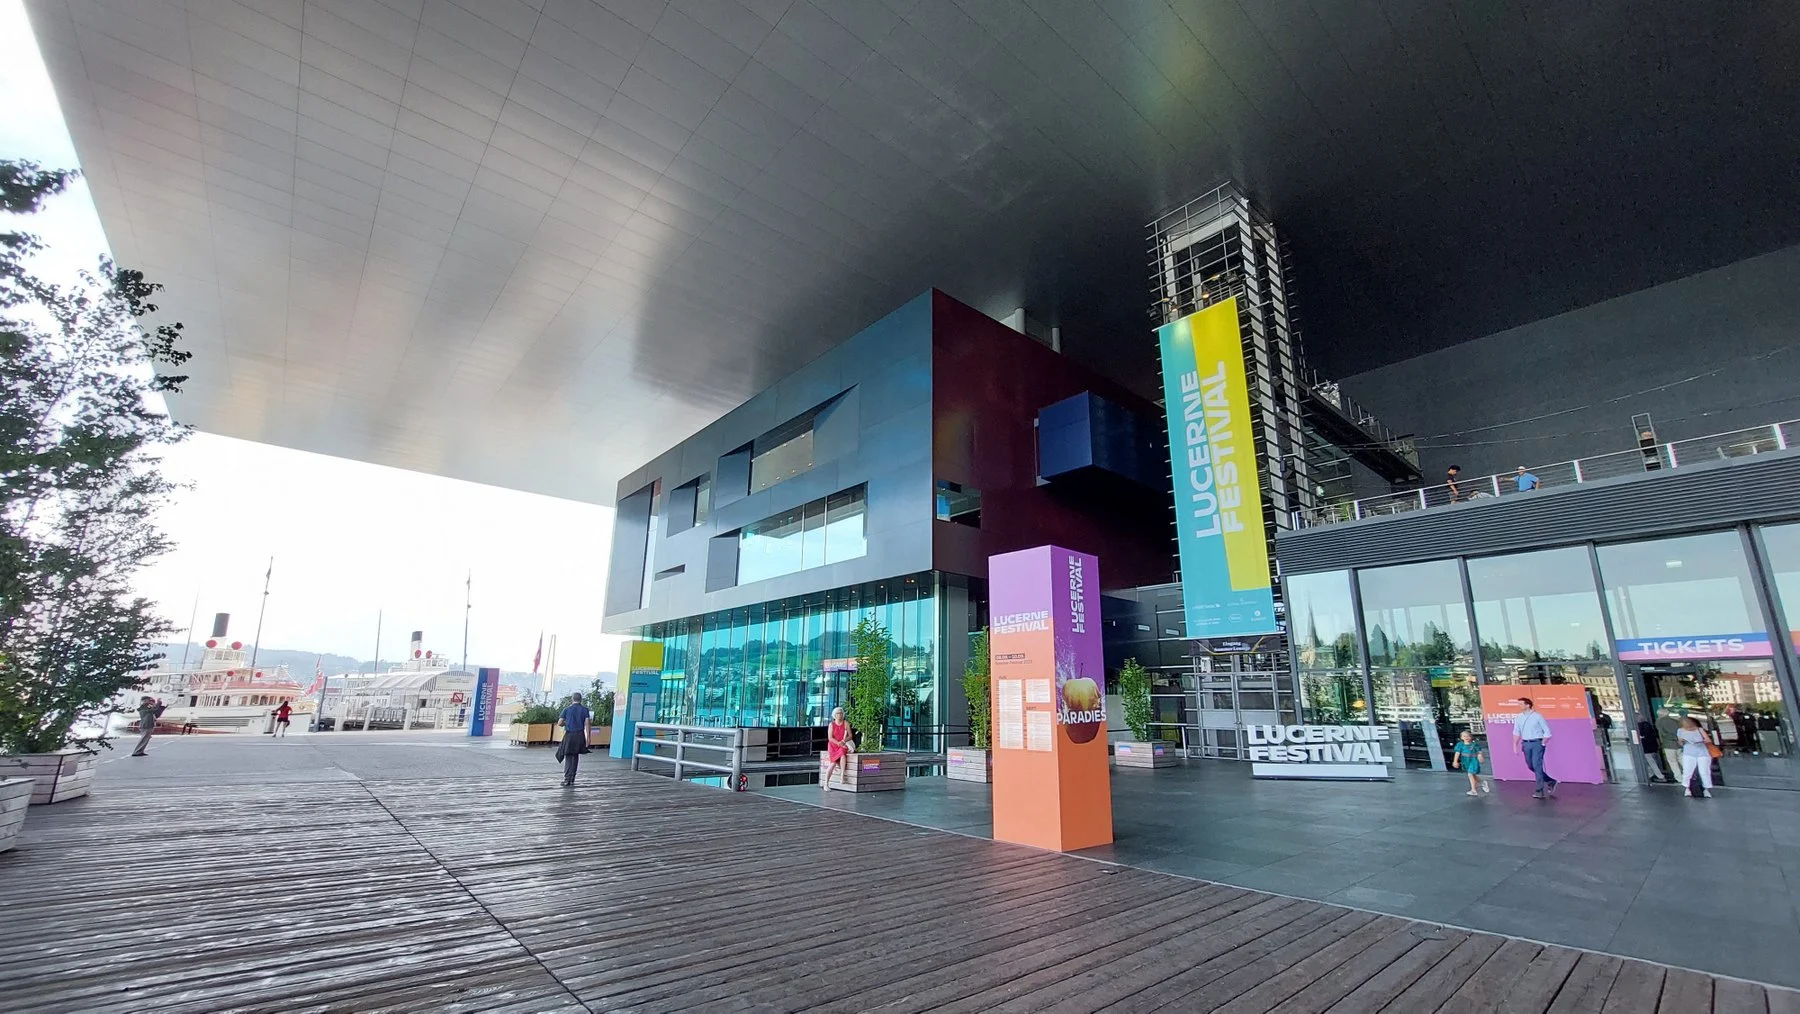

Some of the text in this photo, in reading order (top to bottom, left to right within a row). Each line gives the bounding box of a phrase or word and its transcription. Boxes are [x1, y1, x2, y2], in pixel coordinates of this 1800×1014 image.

[1180, 370, 1222, 539] LUCERNE
[1202, 360, 1245, 534] FESTIVAL
[1069, 555, 1080, 633] LUCERNE
[1075, 557, 1086, 634] FESTIVAL
[994, 610, 1049, 627] LUCERNE
[994, 621, 1049, 635] FESTIVAL
[1638, 638, 1745, 655] TICKETS
[478, 682, 488, 721] LUCERNE
[485, 682, 494, 721] FESTIVAL
[1056, 709, 1107, 725] PARADIES
[1247, 725, 1390, 745] LUCERNE
[1249, 742, 1393, 763] FESTIVAL
